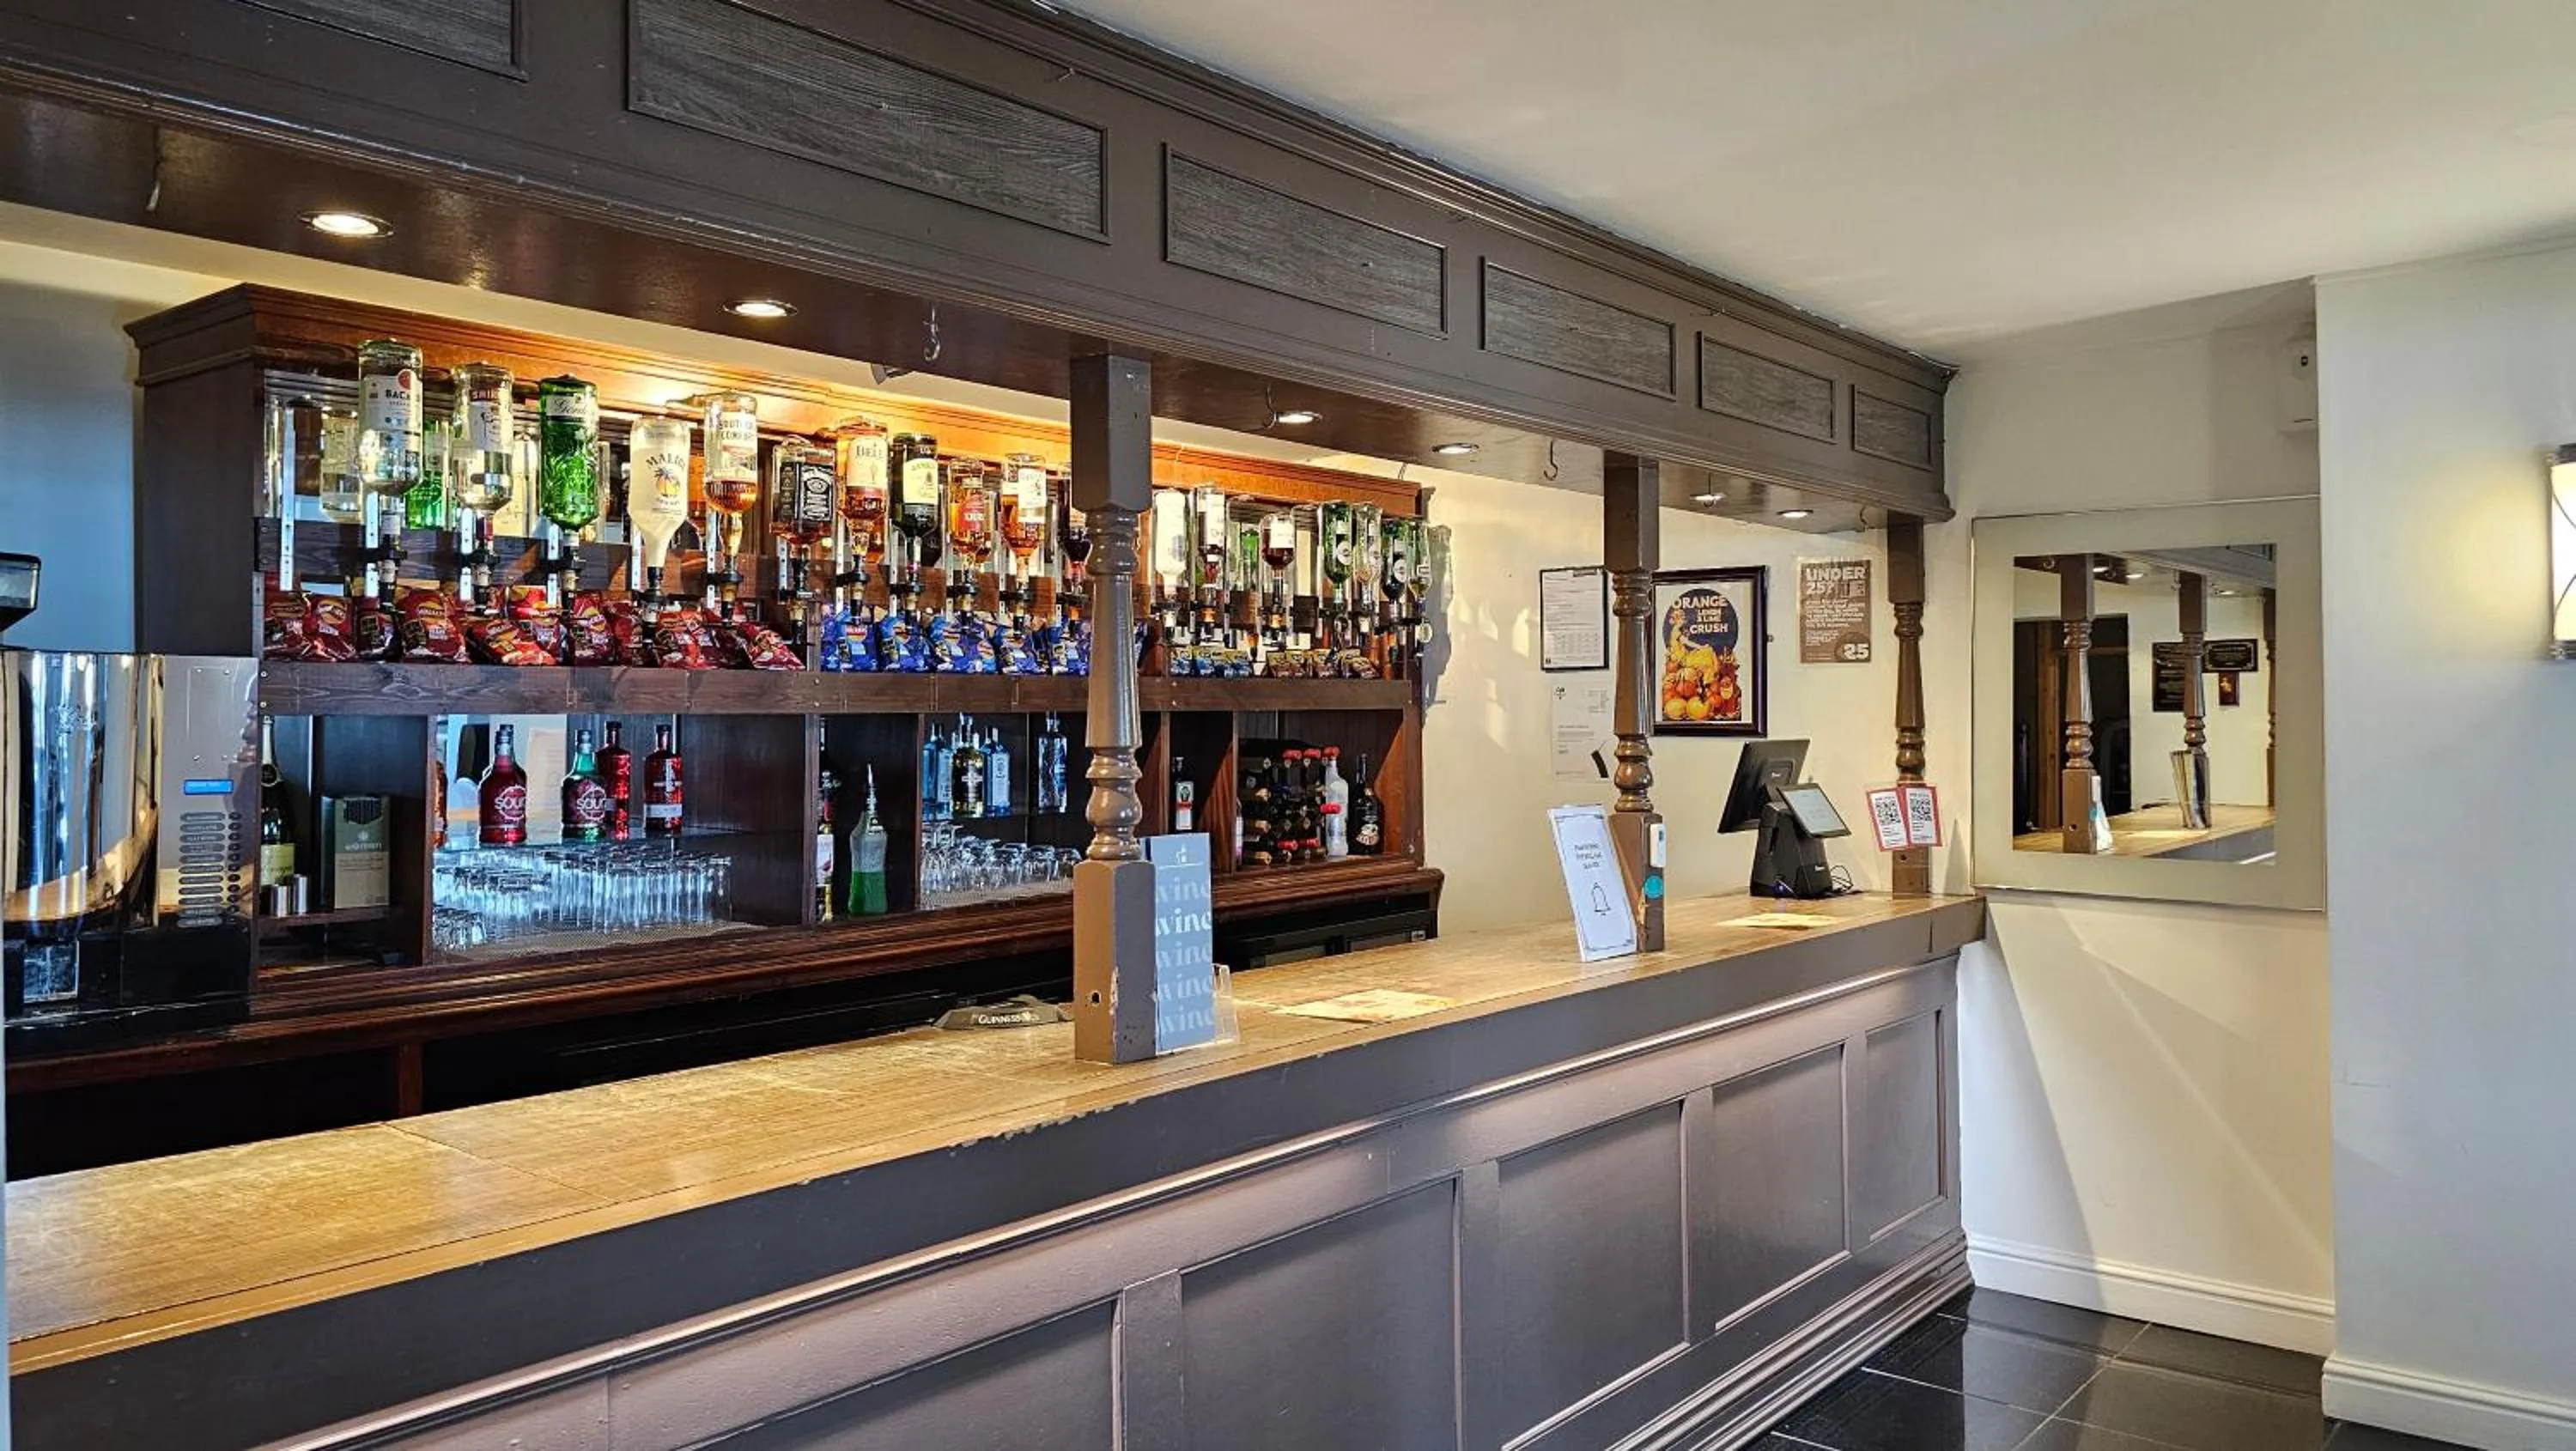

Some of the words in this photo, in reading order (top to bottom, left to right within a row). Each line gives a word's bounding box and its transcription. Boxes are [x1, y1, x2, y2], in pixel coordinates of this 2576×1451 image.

[1806, 566, 1866, 581] UNDER
[1672, 595, 1728, 609] ORANGE
[1689, 622, 1728, 634] CRUSH
[1844, 643, 1869, 660] 25
